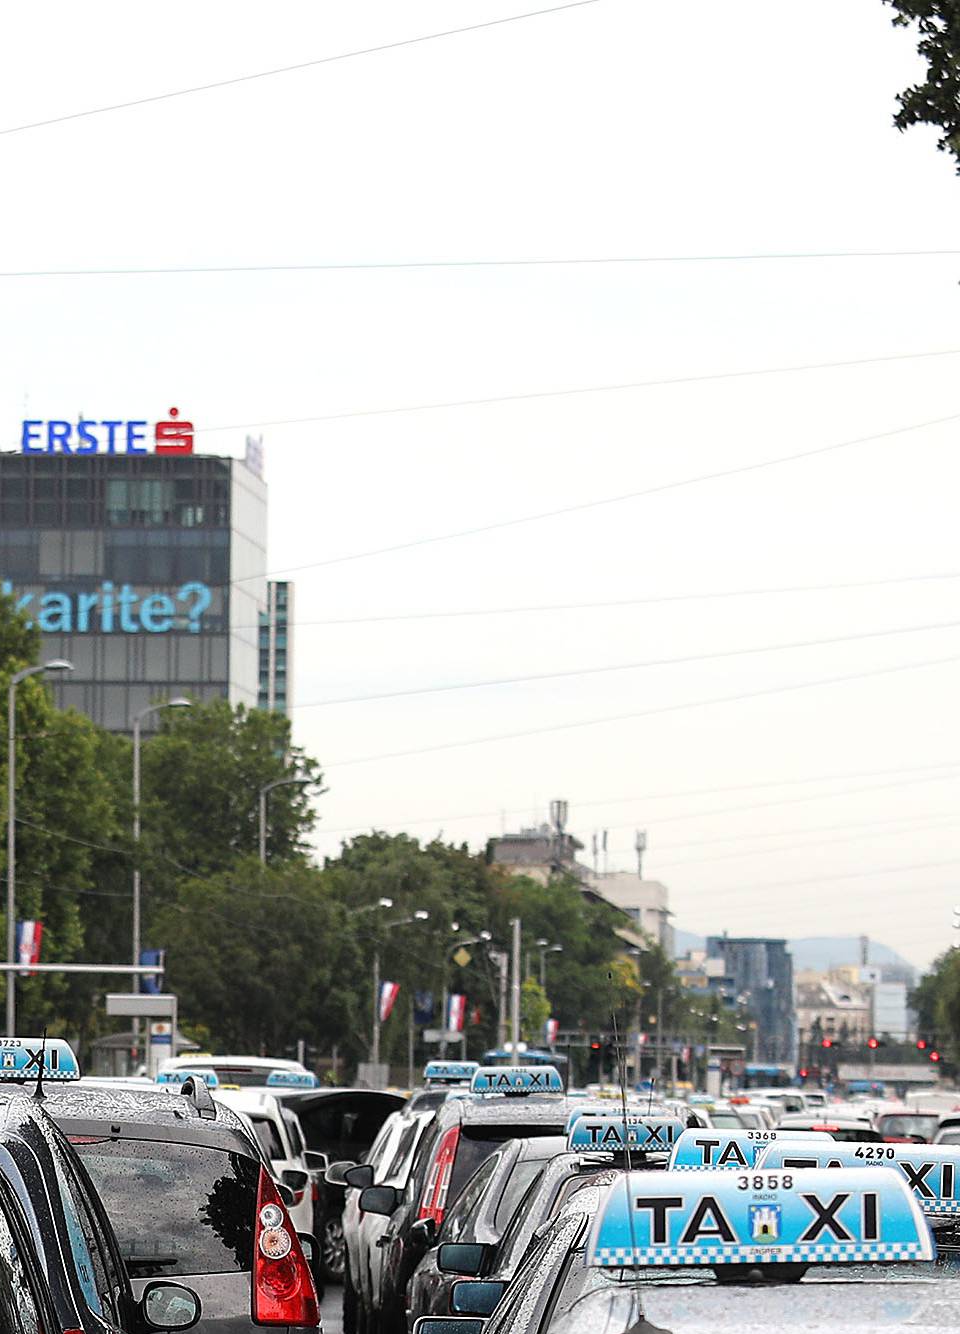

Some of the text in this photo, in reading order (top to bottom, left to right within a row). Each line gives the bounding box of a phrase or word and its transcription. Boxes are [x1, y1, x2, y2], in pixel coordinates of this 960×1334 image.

[22, 420, 148, 455] ERSTE
[747, 1131, 777, 1140] 3368
[855, 1146, 896, 1160] 4290
[737, 1175, 794, 1191] 3858
